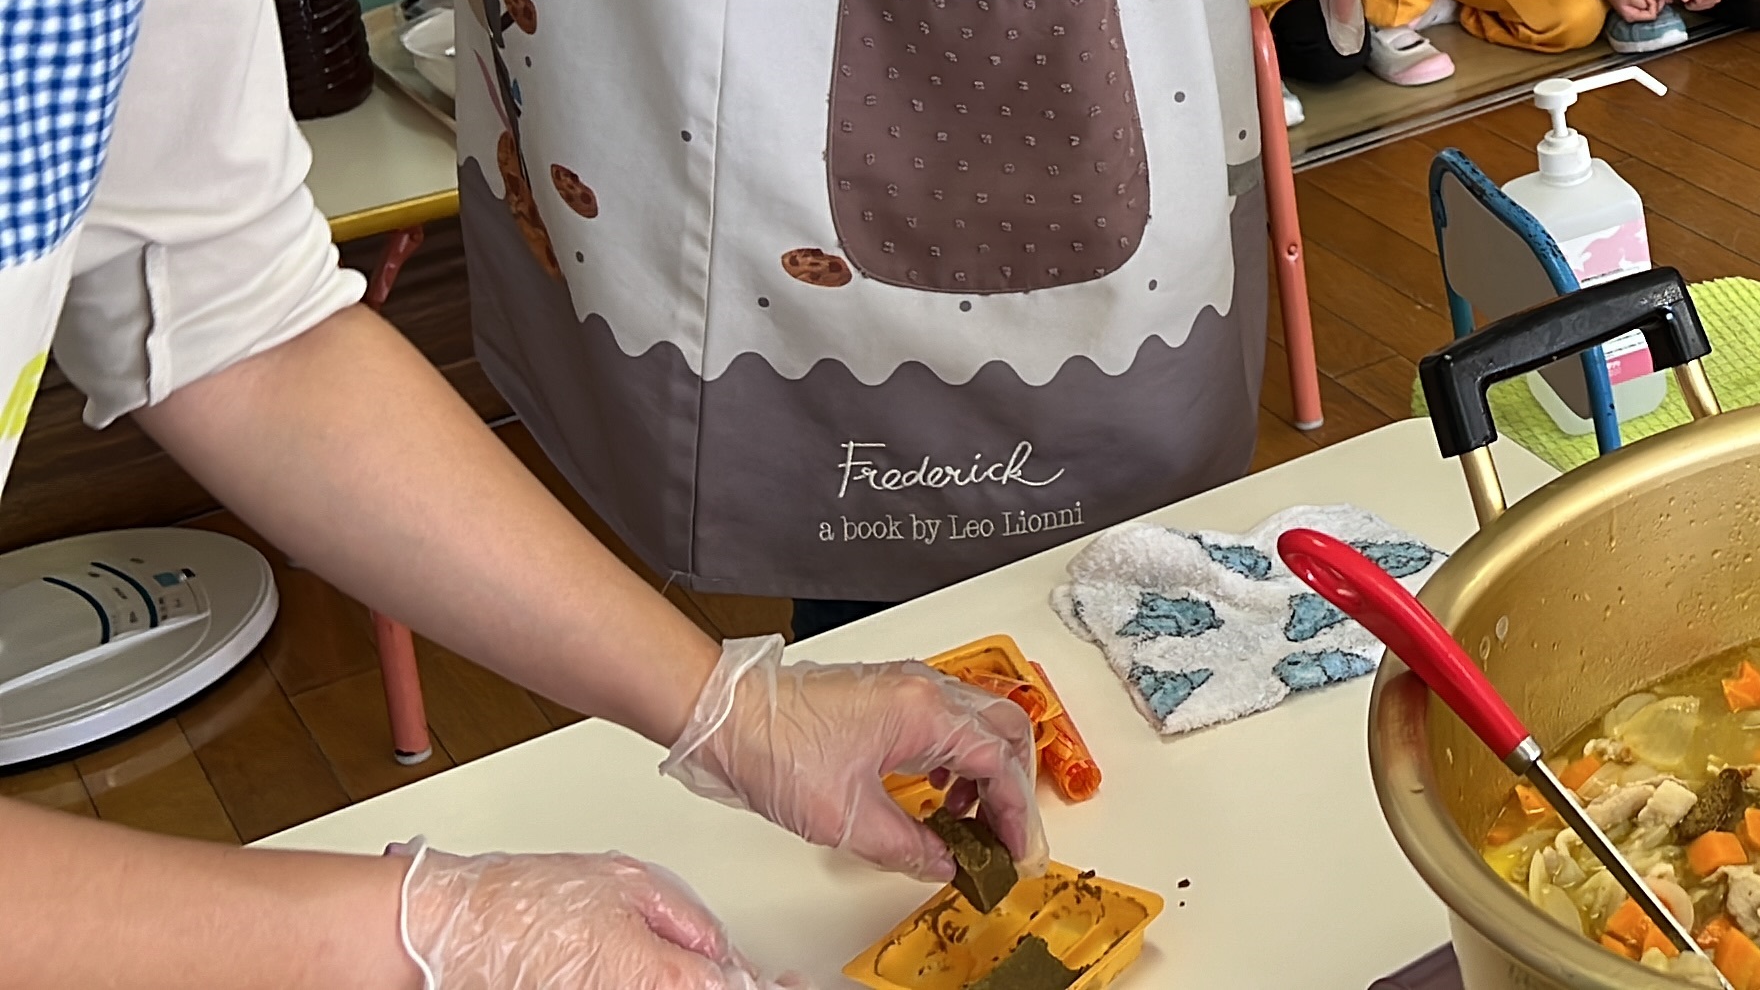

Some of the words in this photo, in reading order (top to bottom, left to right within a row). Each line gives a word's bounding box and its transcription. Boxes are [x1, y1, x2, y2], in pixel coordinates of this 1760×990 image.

[838, 440, 1065, 498] Frederick
[819, 522, 835, 541] a
[841, 514, 904, 541] book
[910, 513, 942, 545] by
[948, 514, 995, 541] Leo
[1001, 501, 1085, 537] Lionni
